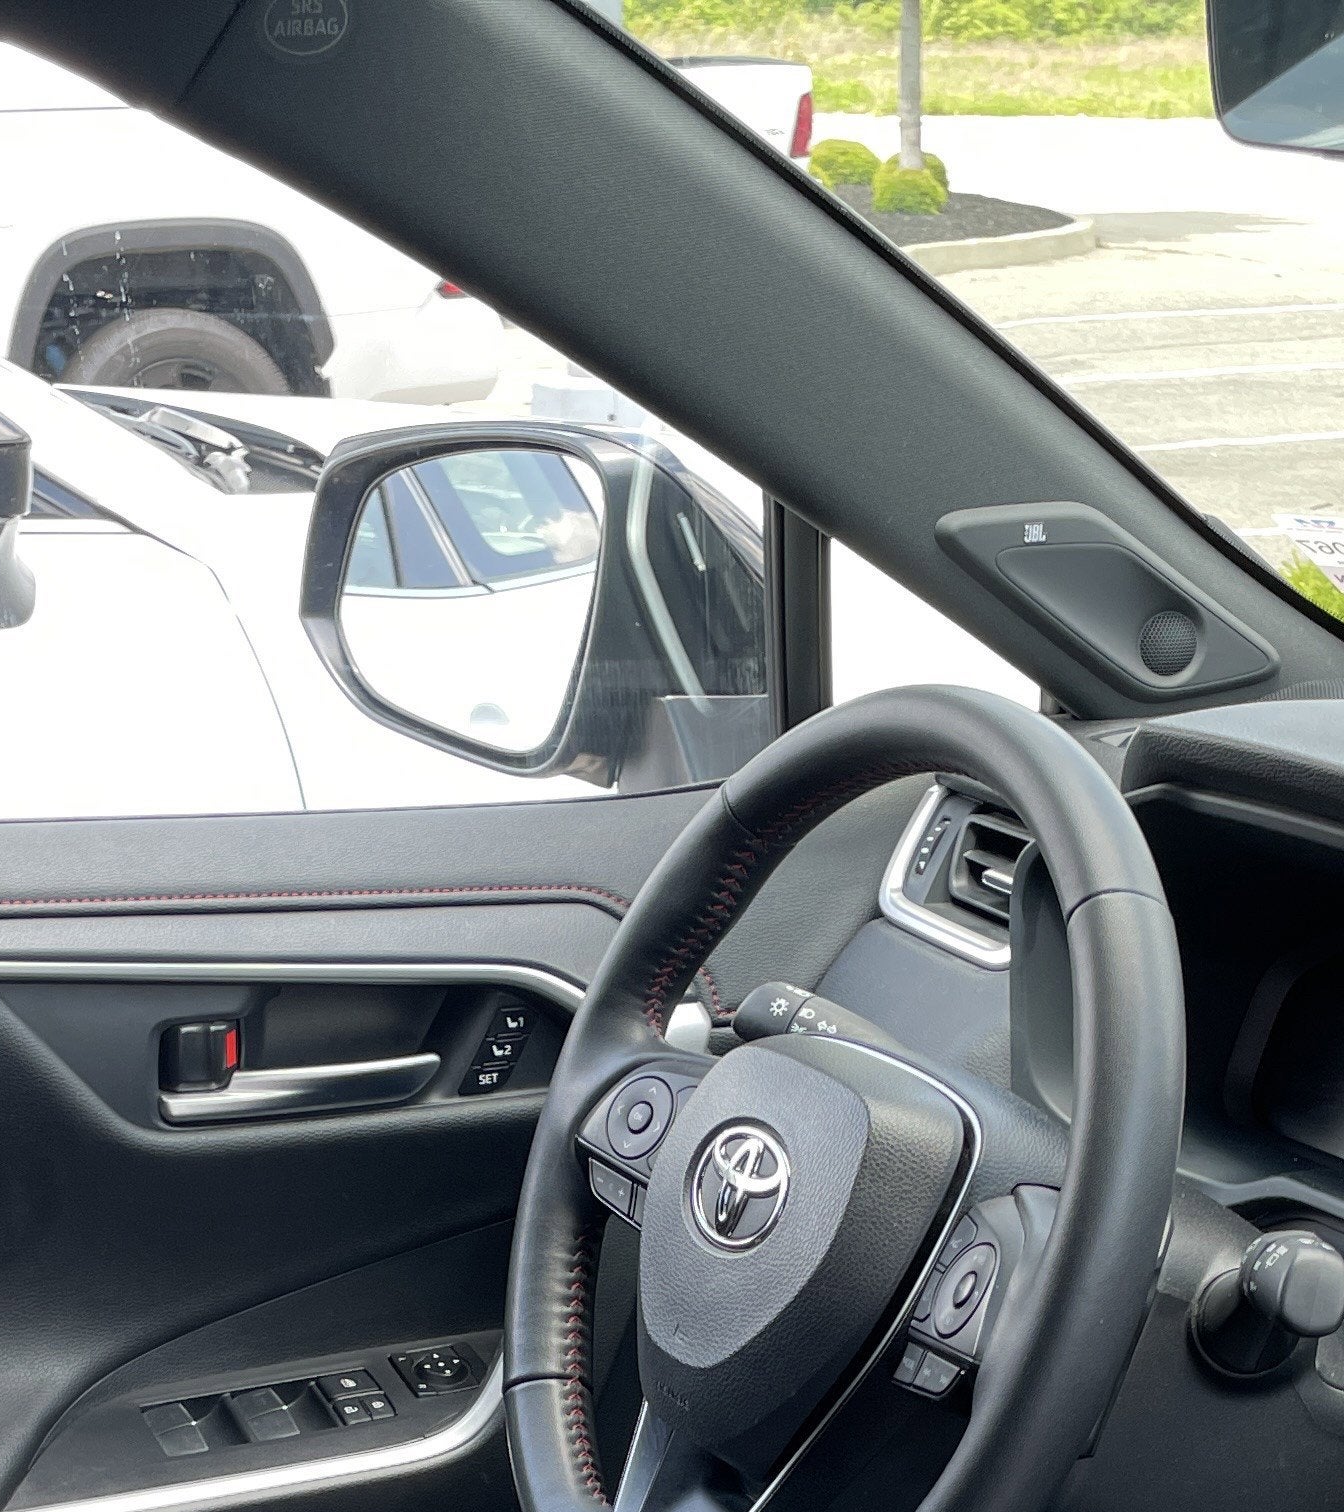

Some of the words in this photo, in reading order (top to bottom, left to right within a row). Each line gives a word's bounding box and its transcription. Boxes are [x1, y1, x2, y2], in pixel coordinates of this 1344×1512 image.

[274, 17, 339, 36] AIRBAG
[1023, 522, 1047, 543] JBL
[478, 1072, 499, 1085] SET
